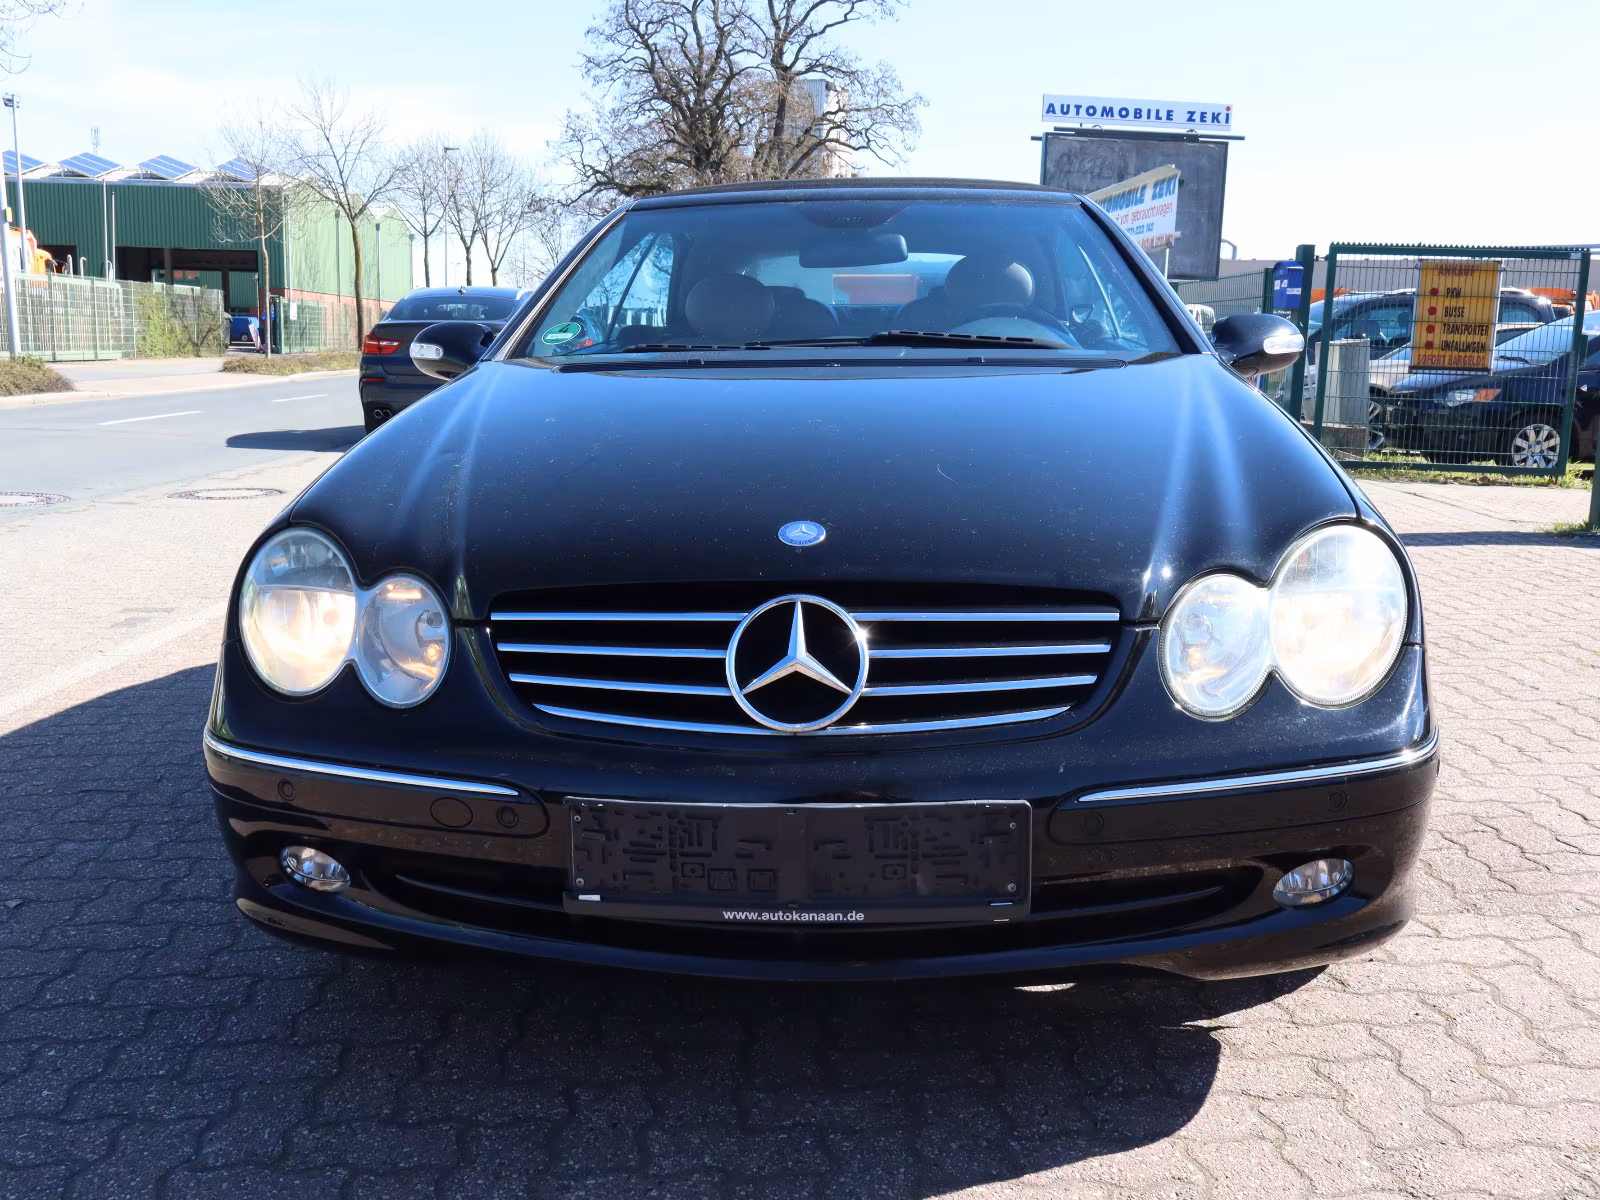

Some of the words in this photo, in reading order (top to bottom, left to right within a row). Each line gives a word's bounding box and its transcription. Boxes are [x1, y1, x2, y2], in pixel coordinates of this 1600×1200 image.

[1046, 103, 1174, 121] AUTOMOBILE
[1151, 175, 1178, 201] ZEKI
[1446, 287, 1462, 298] PKW
[1444, 306, 1465, 317] BUSSE
[1443, 323, 1489, 336] TRANSPORTER
[1417, 354, 1446, 366] SOFORT
[723, 910, 865, 921] www.autokanaan.de
